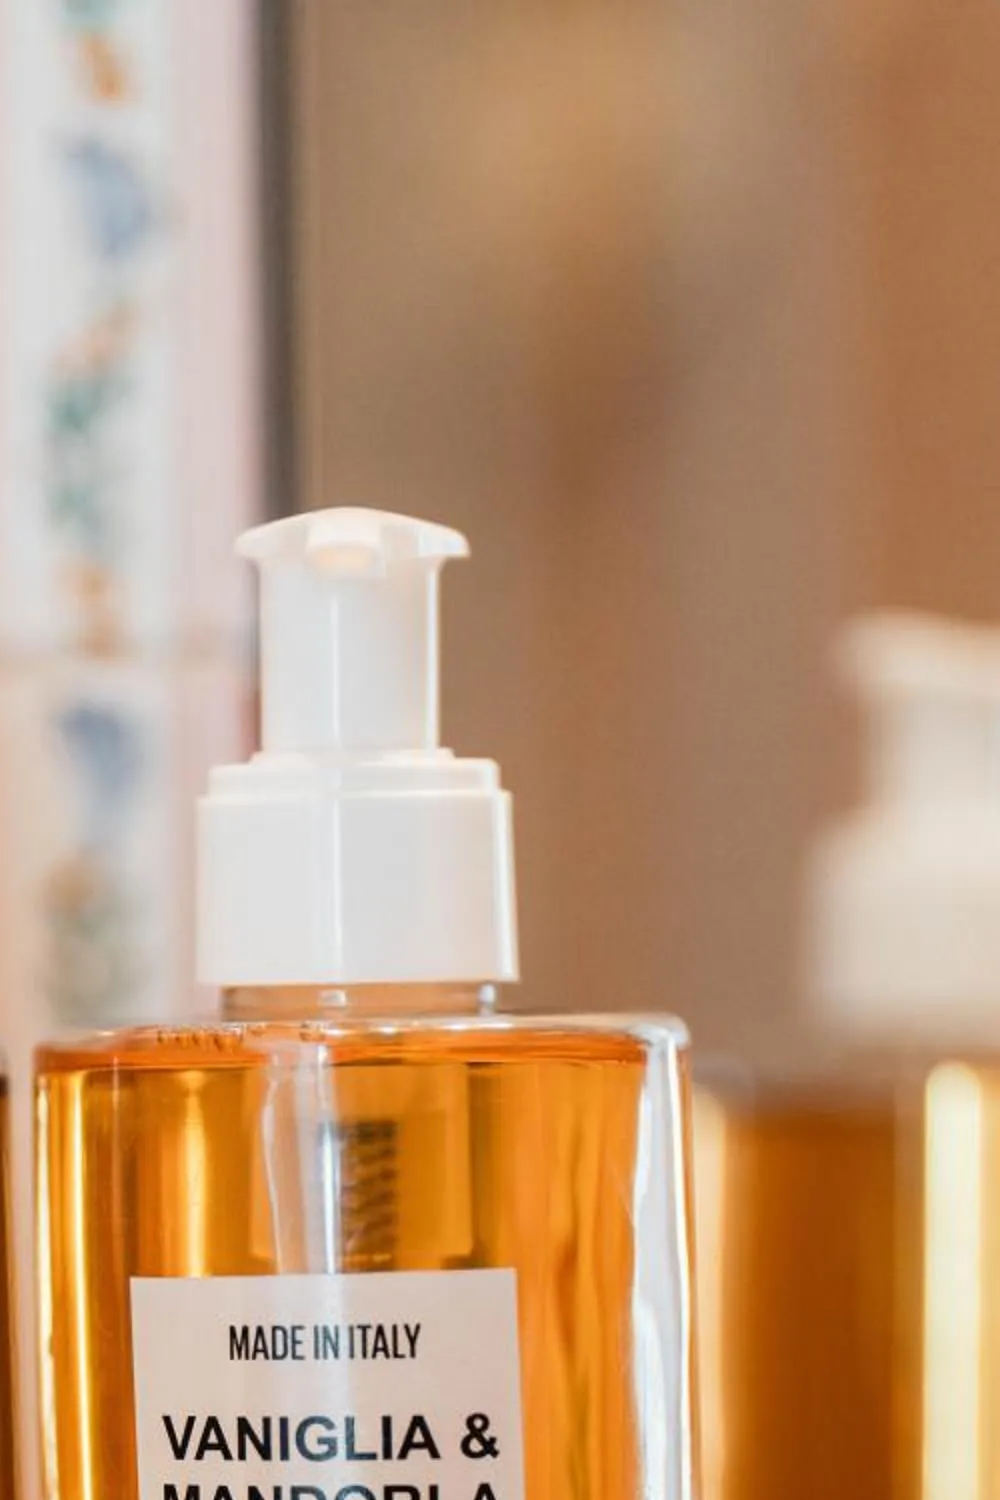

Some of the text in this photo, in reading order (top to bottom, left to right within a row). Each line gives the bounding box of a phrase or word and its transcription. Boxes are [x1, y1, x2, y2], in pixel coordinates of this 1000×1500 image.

[229, 1323, 421, 1361] MADE IN ITALY
[162, 1412, 500, 1461] VANIGLIA &
